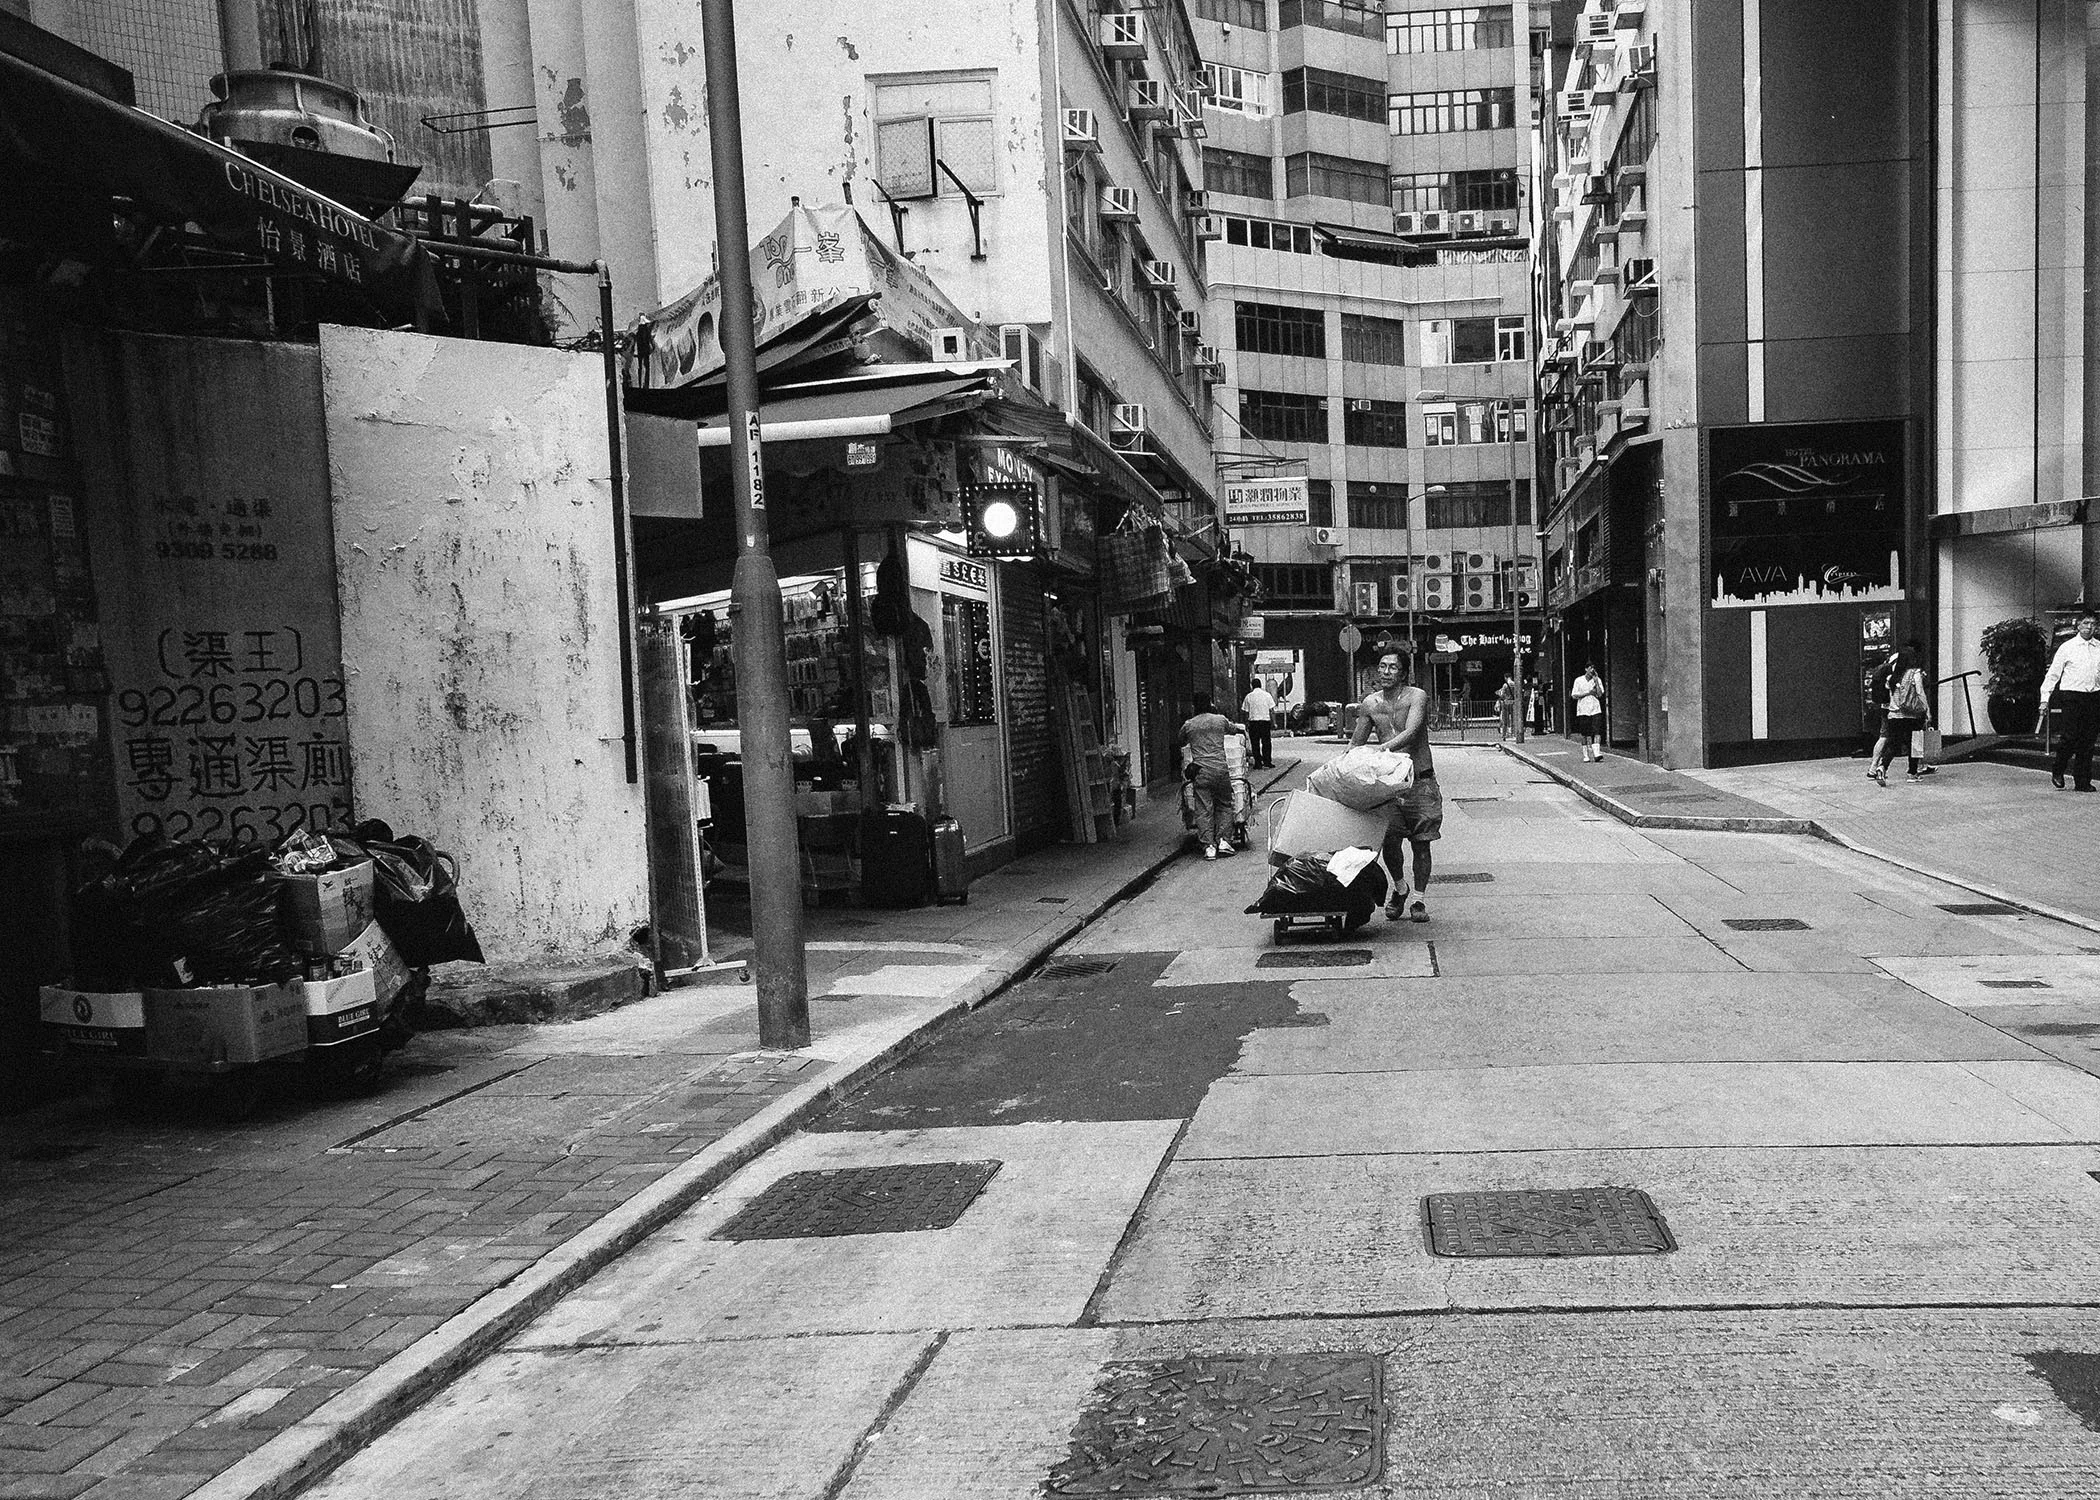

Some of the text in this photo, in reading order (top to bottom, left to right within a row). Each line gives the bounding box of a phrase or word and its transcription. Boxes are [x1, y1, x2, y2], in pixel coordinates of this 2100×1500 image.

[257, 216, 361, 283] 怡景酒店
[997, 447, 1033, 482] MONEY
[1800, 452, 1886, 467] PANORAMA
[751, 450, 764, 505] 1182
[1739, 565, 1788, 584] AVA
[1460, 634, 1478, 647] The
[119, 677, 347, 728] 92263203
